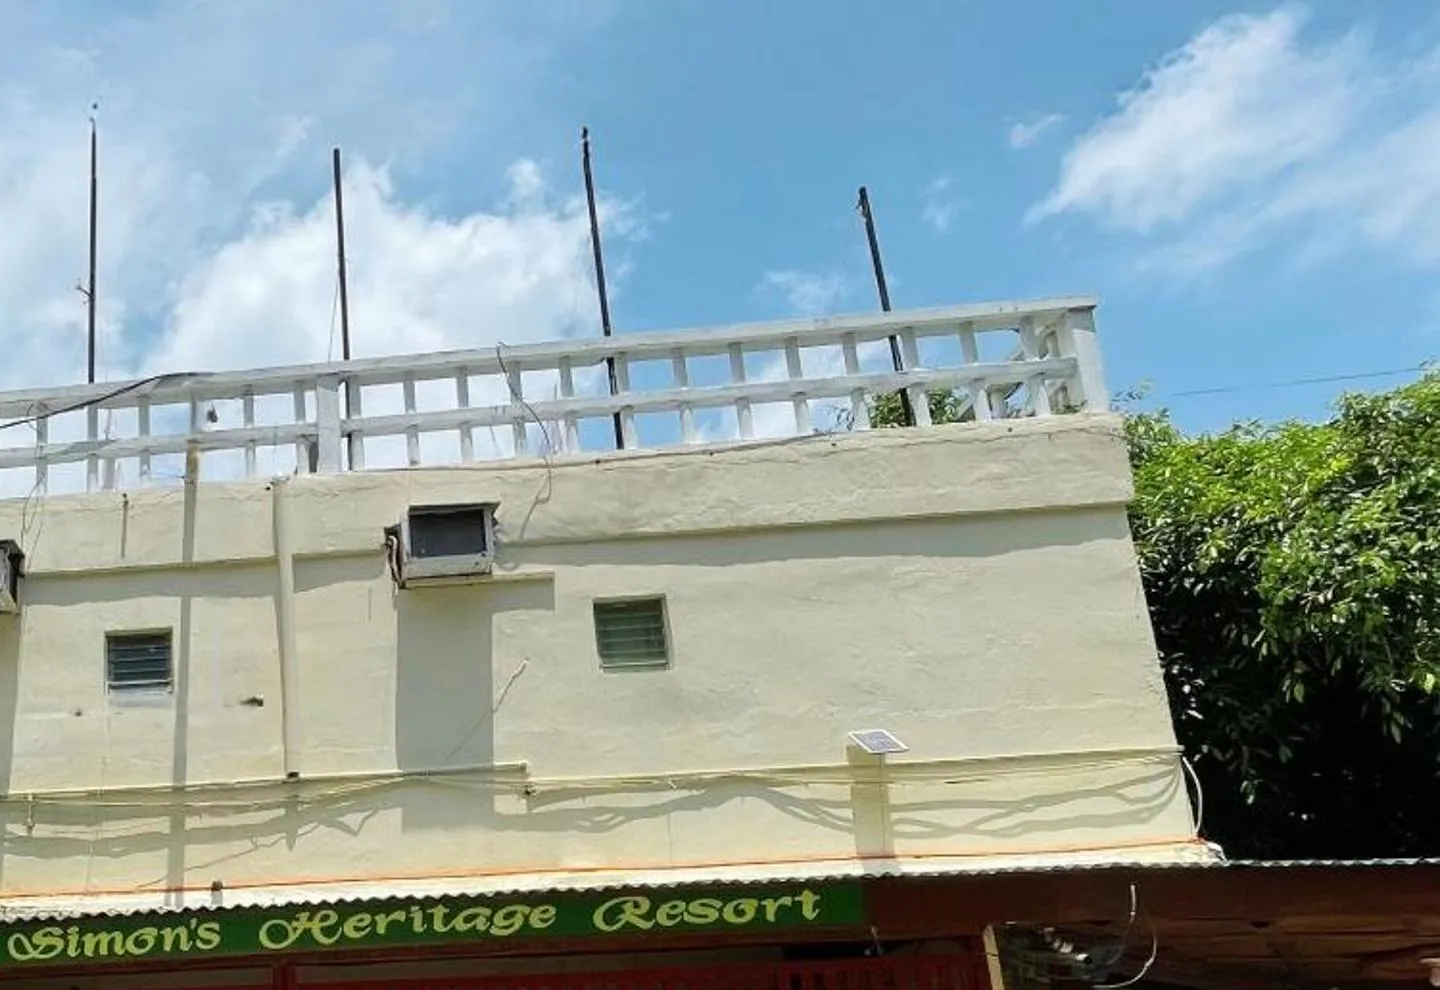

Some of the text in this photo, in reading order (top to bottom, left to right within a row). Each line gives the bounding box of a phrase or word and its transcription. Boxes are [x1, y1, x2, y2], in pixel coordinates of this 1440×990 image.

[7, 888, 822, 961] Simon's Heritage Resort
